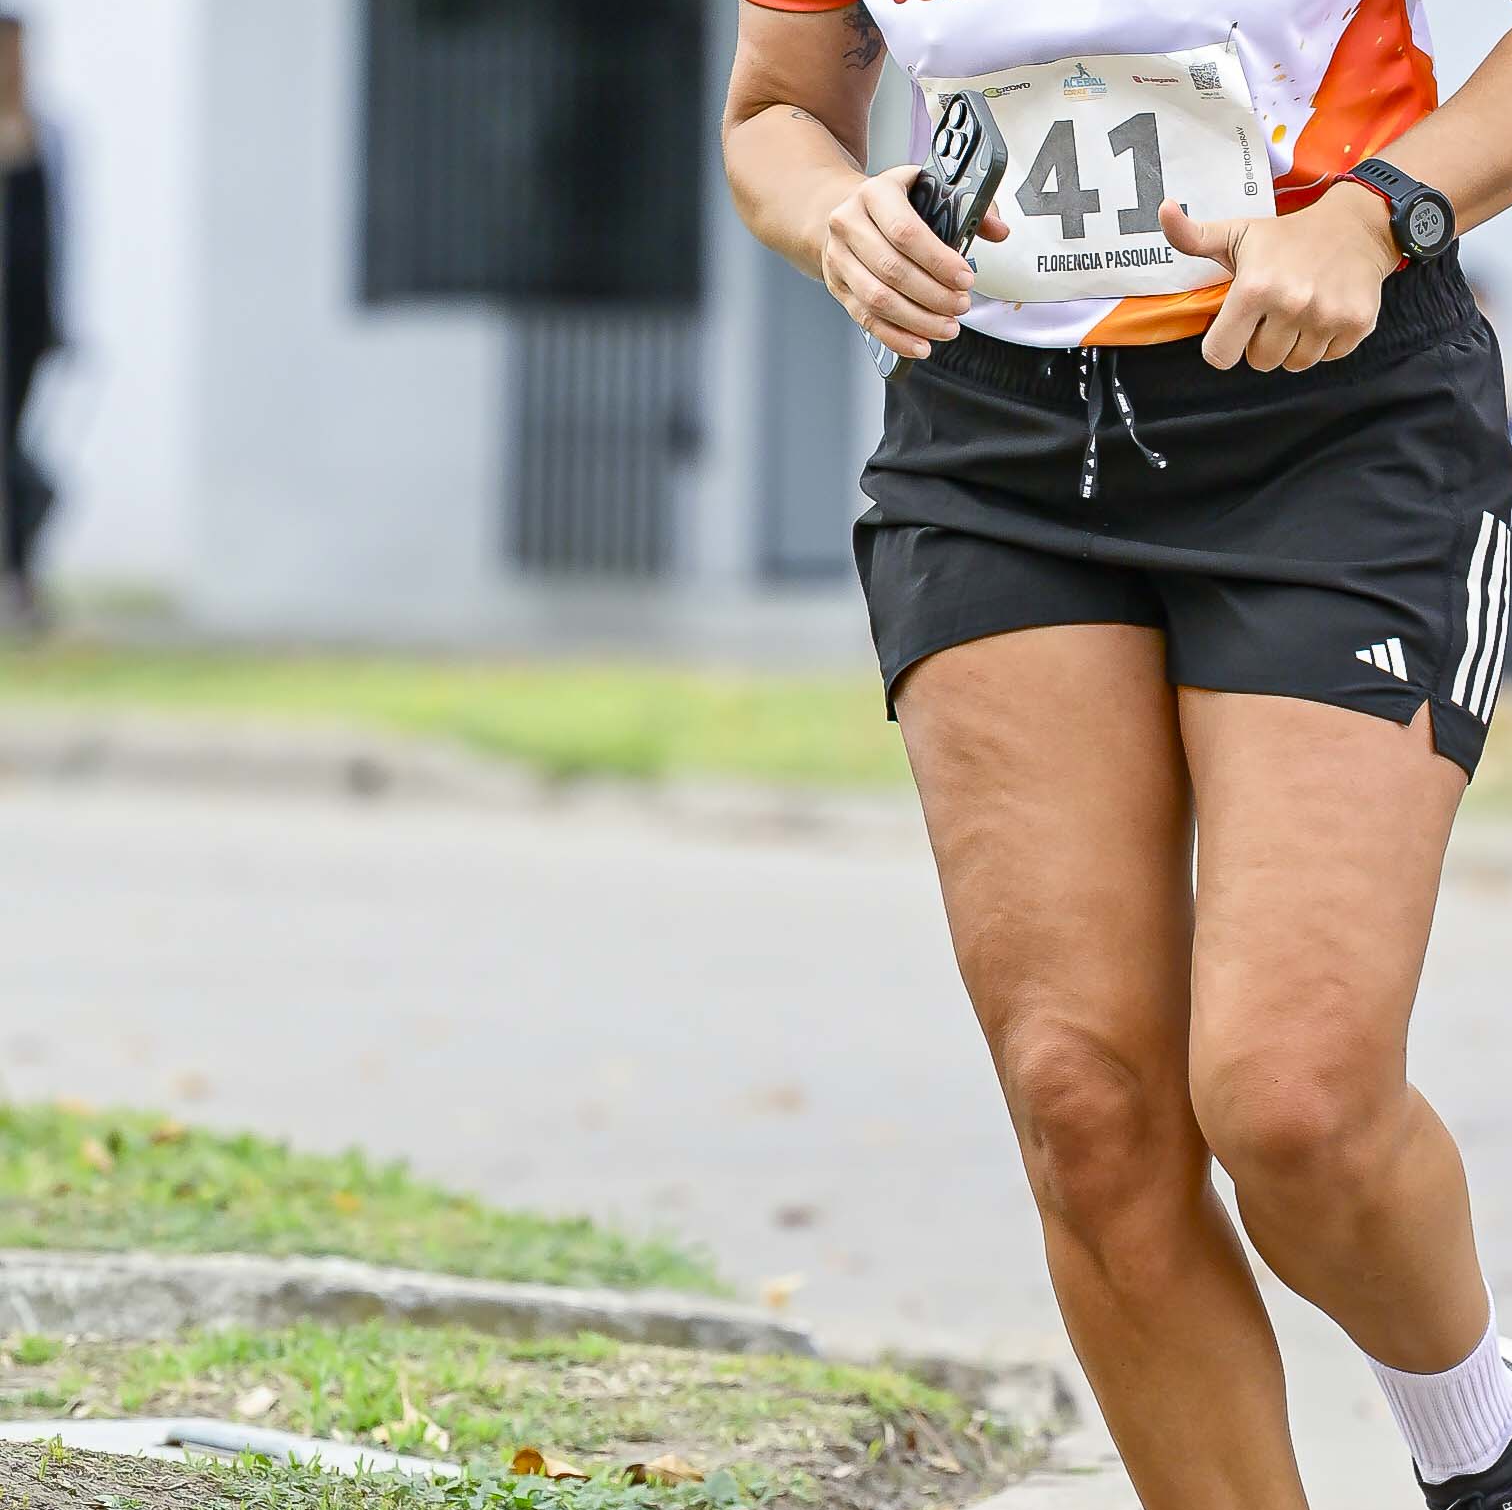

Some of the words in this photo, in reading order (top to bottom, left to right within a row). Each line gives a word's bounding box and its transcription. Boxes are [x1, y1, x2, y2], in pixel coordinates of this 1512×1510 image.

[1014, 112, 1188, 239] 41
[1037, 254, 1103, 273] FLORENCIA
[1105, 246, 1174, 269] PASQUALE
